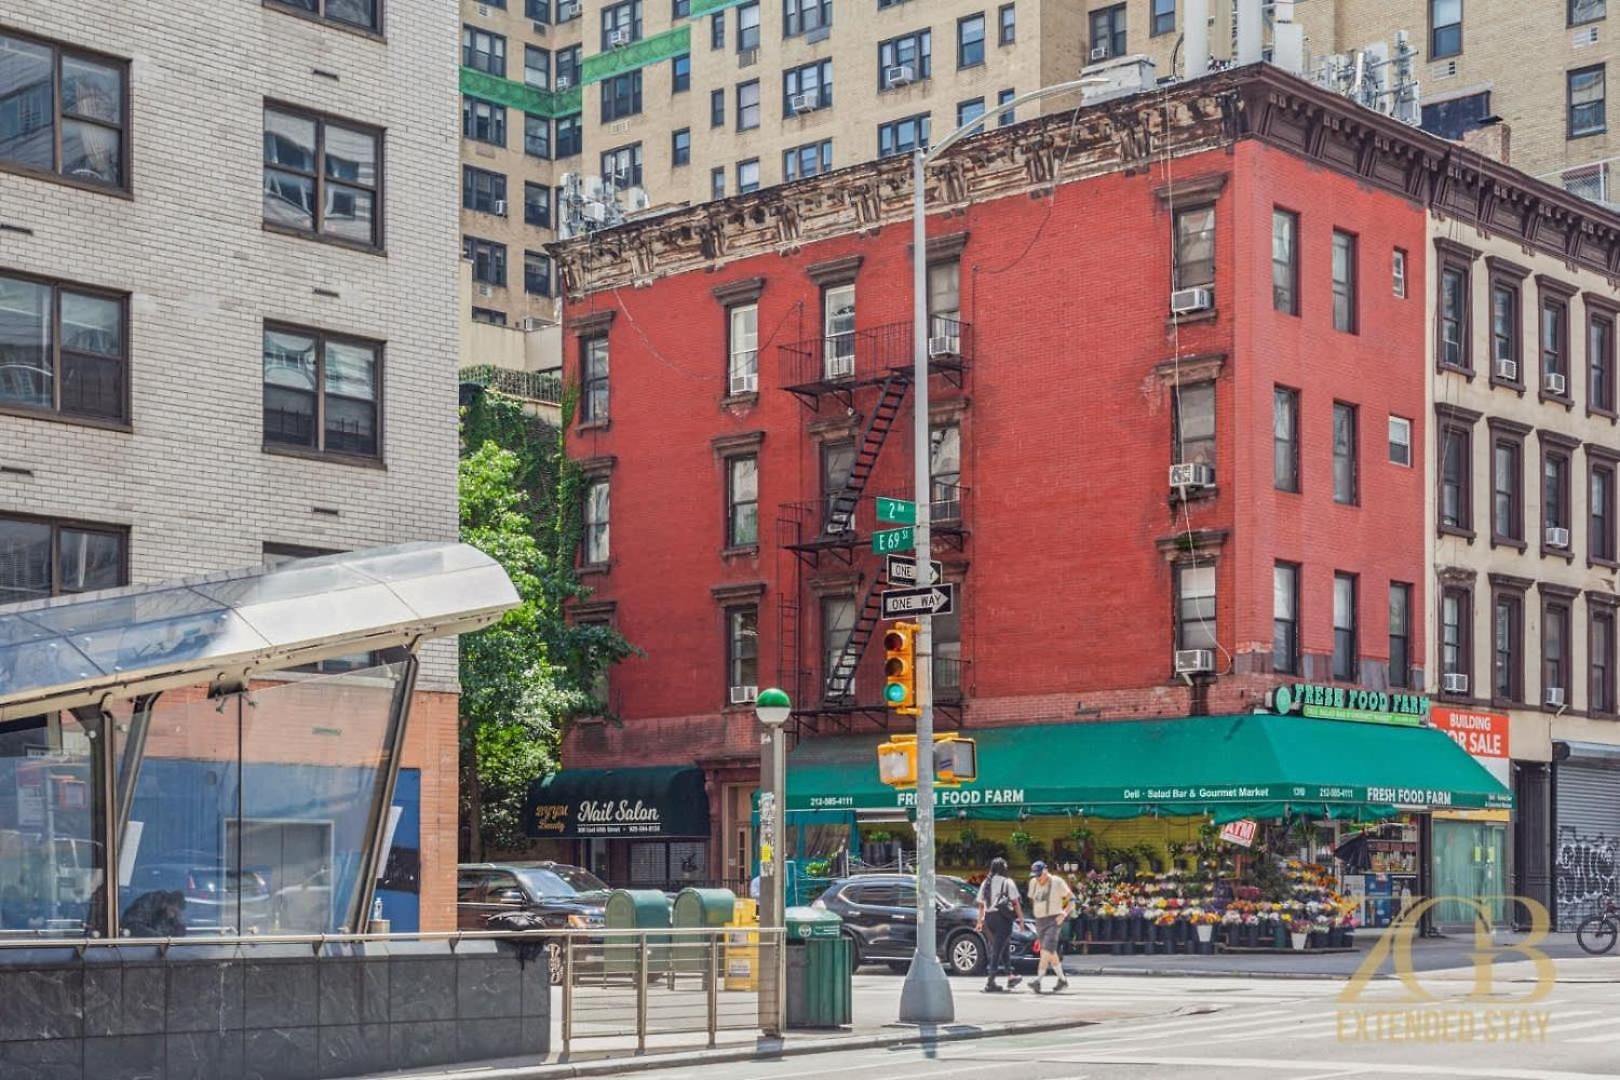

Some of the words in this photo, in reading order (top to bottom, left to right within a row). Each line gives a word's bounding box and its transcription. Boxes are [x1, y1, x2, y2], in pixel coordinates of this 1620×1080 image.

[889, 502, 896, 519] 2
[879, 534, 885, 550] E
[887, 532, 900, 549] 69
[895, 565, 912, 577] ONE
[892, 598, 912, 610] ONE
[921, 594, 941, 608] WAY
[1294, 683, 1344, 707] FRESH
[1348, 689, 1390, 713] FOOD
[1392, 694, 1430, 716] FARM
[1449, 712, 1491, 731] BUILDING
[1469, 732, 1501, 754] SALE
[942, 790, 981, 804] FOOD
[984, 789, 1024, 803] FARM
[1124, 789, 1140, 798] Deli
[1147, 788, 1170, 798] Salad
[1172, 788, 1187, 798] Bar
[1189, 788, 1196, 798] &
[1199, 788, 1237, 797] Gourmet
[1238, 787, 1269, 797] Market
[1367, 787, 1396, 802] FRESH
[1398, 789, 1425, 803] FOOD
[1426, 790, 1451, 805] FARM
[577, 800, 614, 822] Nail
[615, 799, 660, 821] Salon
[1224, 822, 1253, 840] ATM
